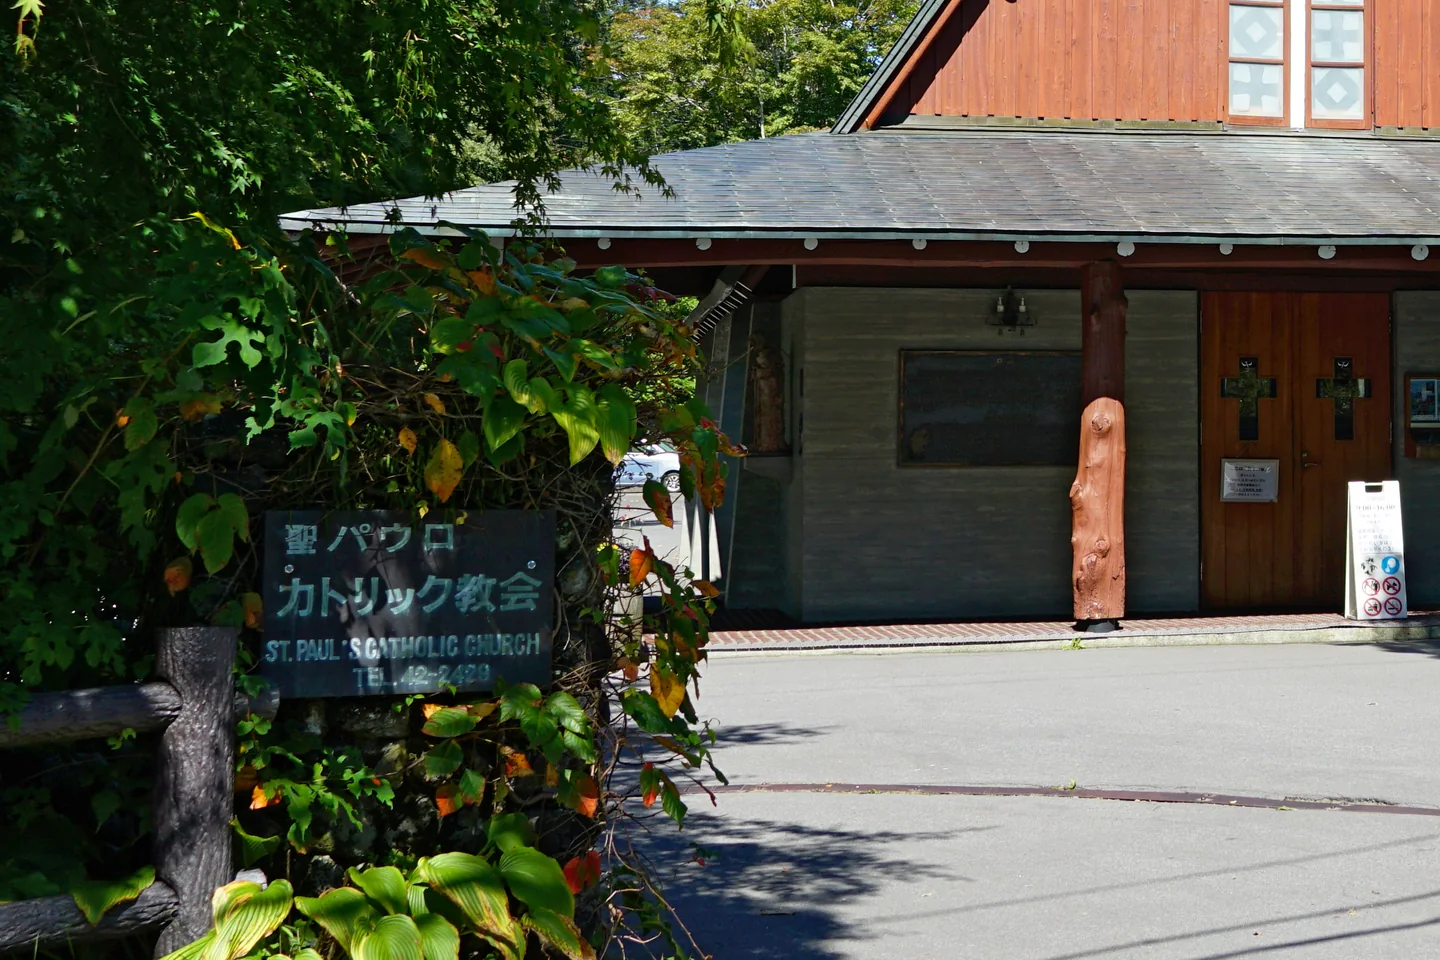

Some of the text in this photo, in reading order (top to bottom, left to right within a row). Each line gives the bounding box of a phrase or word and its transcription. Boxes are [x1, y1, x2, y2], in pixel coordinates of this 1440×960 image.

[285, 523, 454, 555] 聖パウロ
[277, 571, 543, 618] カトリック教会
[365, 634, 458, 659] CATHOLIC
[464, 632, 541, 657] CHURCH
